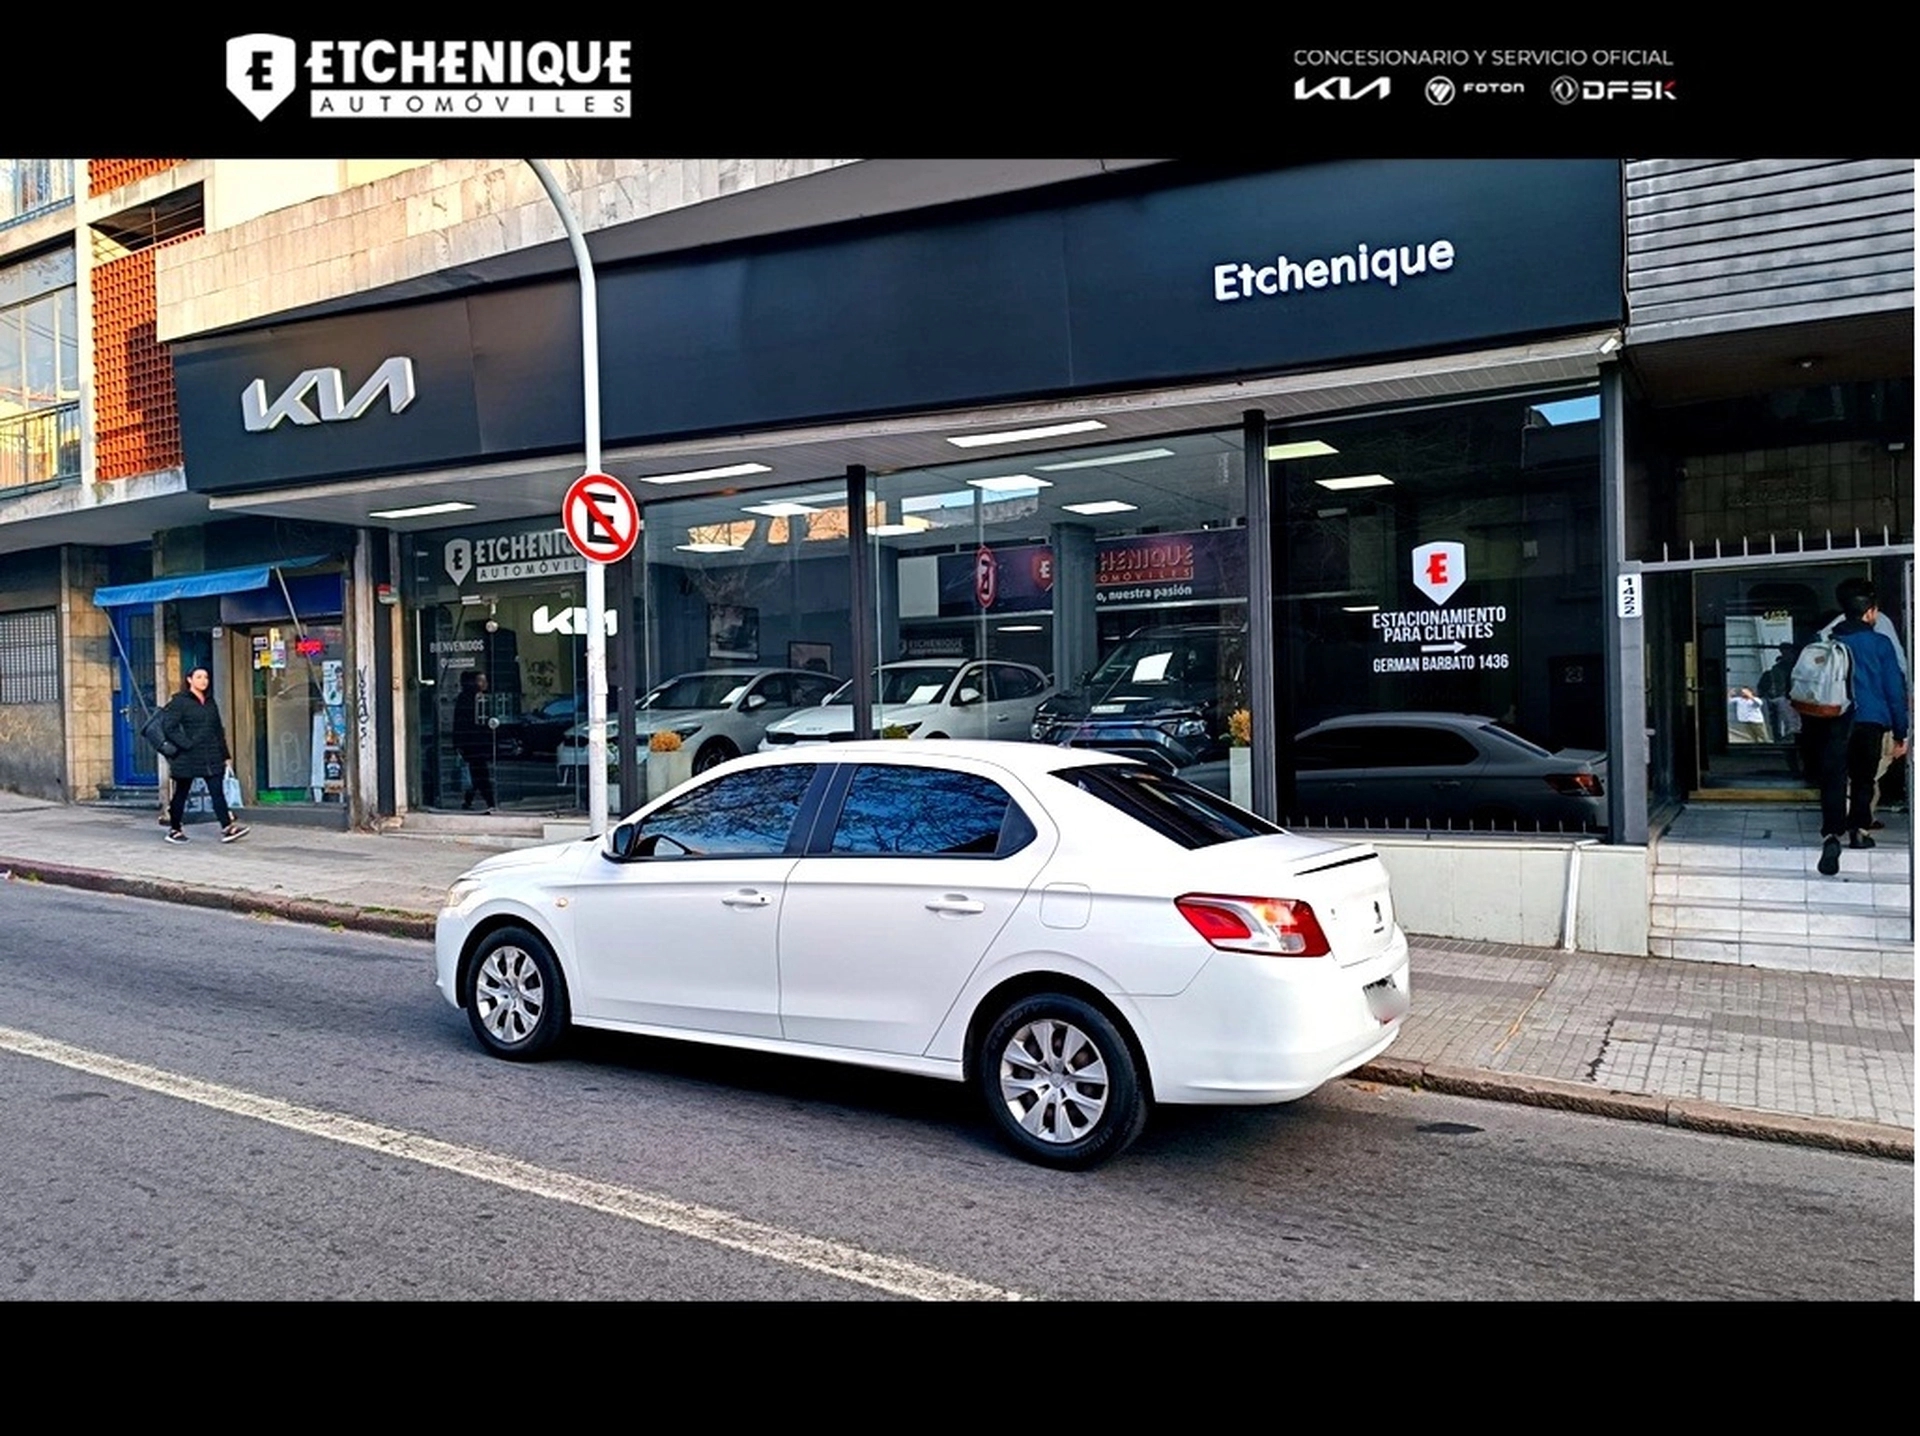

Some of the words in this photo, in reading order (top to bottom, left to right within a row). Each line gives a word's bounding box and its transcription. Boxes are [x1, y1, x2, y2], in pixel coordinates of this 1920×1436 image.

[1214, 240, 1455, 301] Etchenique
[242, 356, 416, 432] KIA
[475, 530, 579, 565] ETCHENI
[1099, 544, 1194, 572] HENIQUE
[481, 557, 581, 580] AUTOMÓVIL
[1100, 568, 1191, 583] OMÓVILES
[1108, 588, 1152, 600] nuestra
[1153, 583, 1193, 600] pasión
[1623, 577, 1635, 615] 1422
[1372, 606, 1506, 629] ESTACIONAMIENTO
[1384, 627, 1422, 643] PARA
[1424, 622, 1494, 641] CLIENTES
[429, 639, 485, 653] BIENVENIDOS
[1373, 657, 1420, 673] GERMAN
[1422, 655, 1475, 671] BARBATO
[1479, 654, 1509, 669] 1436
